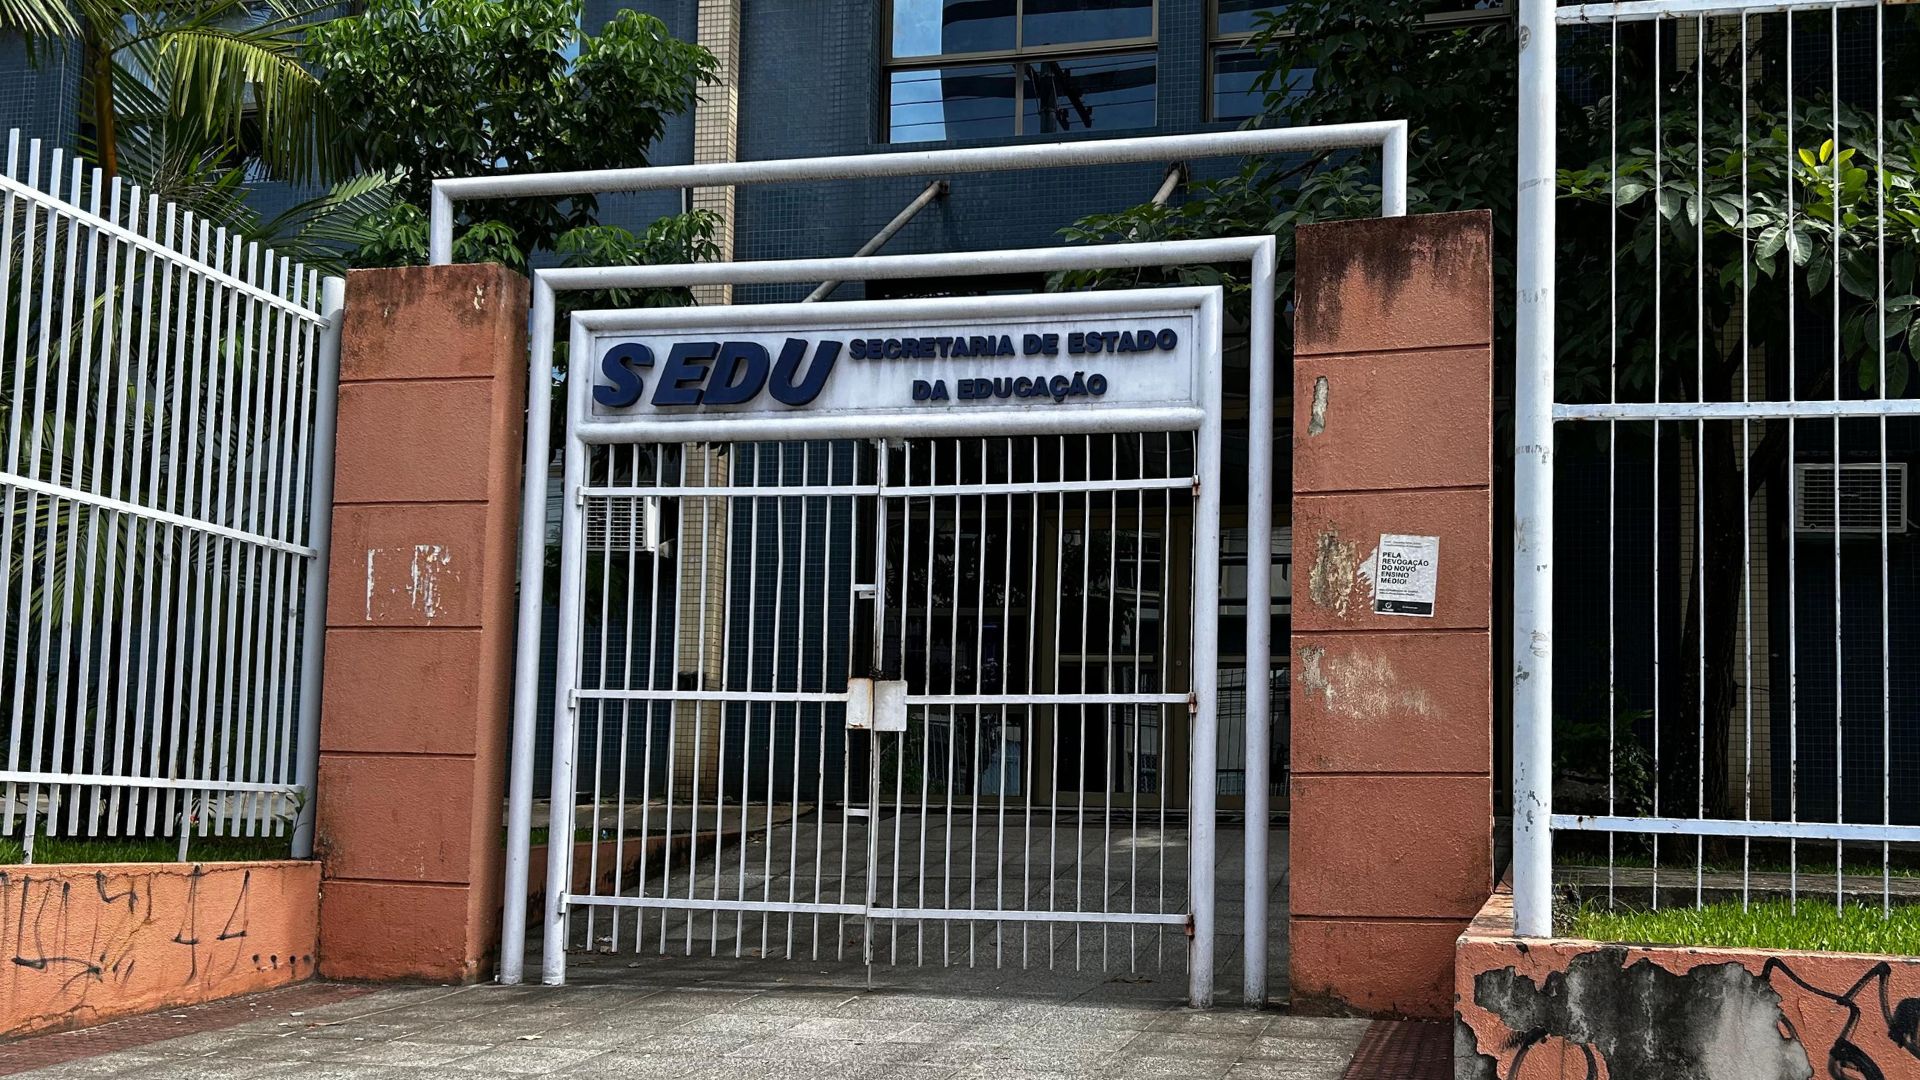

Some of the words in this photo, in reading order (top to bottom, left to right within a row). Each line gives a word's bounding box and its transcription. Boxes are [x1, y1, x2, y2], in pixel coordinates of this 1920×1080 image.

[849, 334, 1015, 360] SECRETARIA
[1023, 333, 1059, 356] DE
[1068, 328, 1178, 355] ESTADO
[592, 338, 843, 408] SEDU
[912, 379, 949, 401] DA
[957, 371, 1108, 402] EDUCAÇÃO
